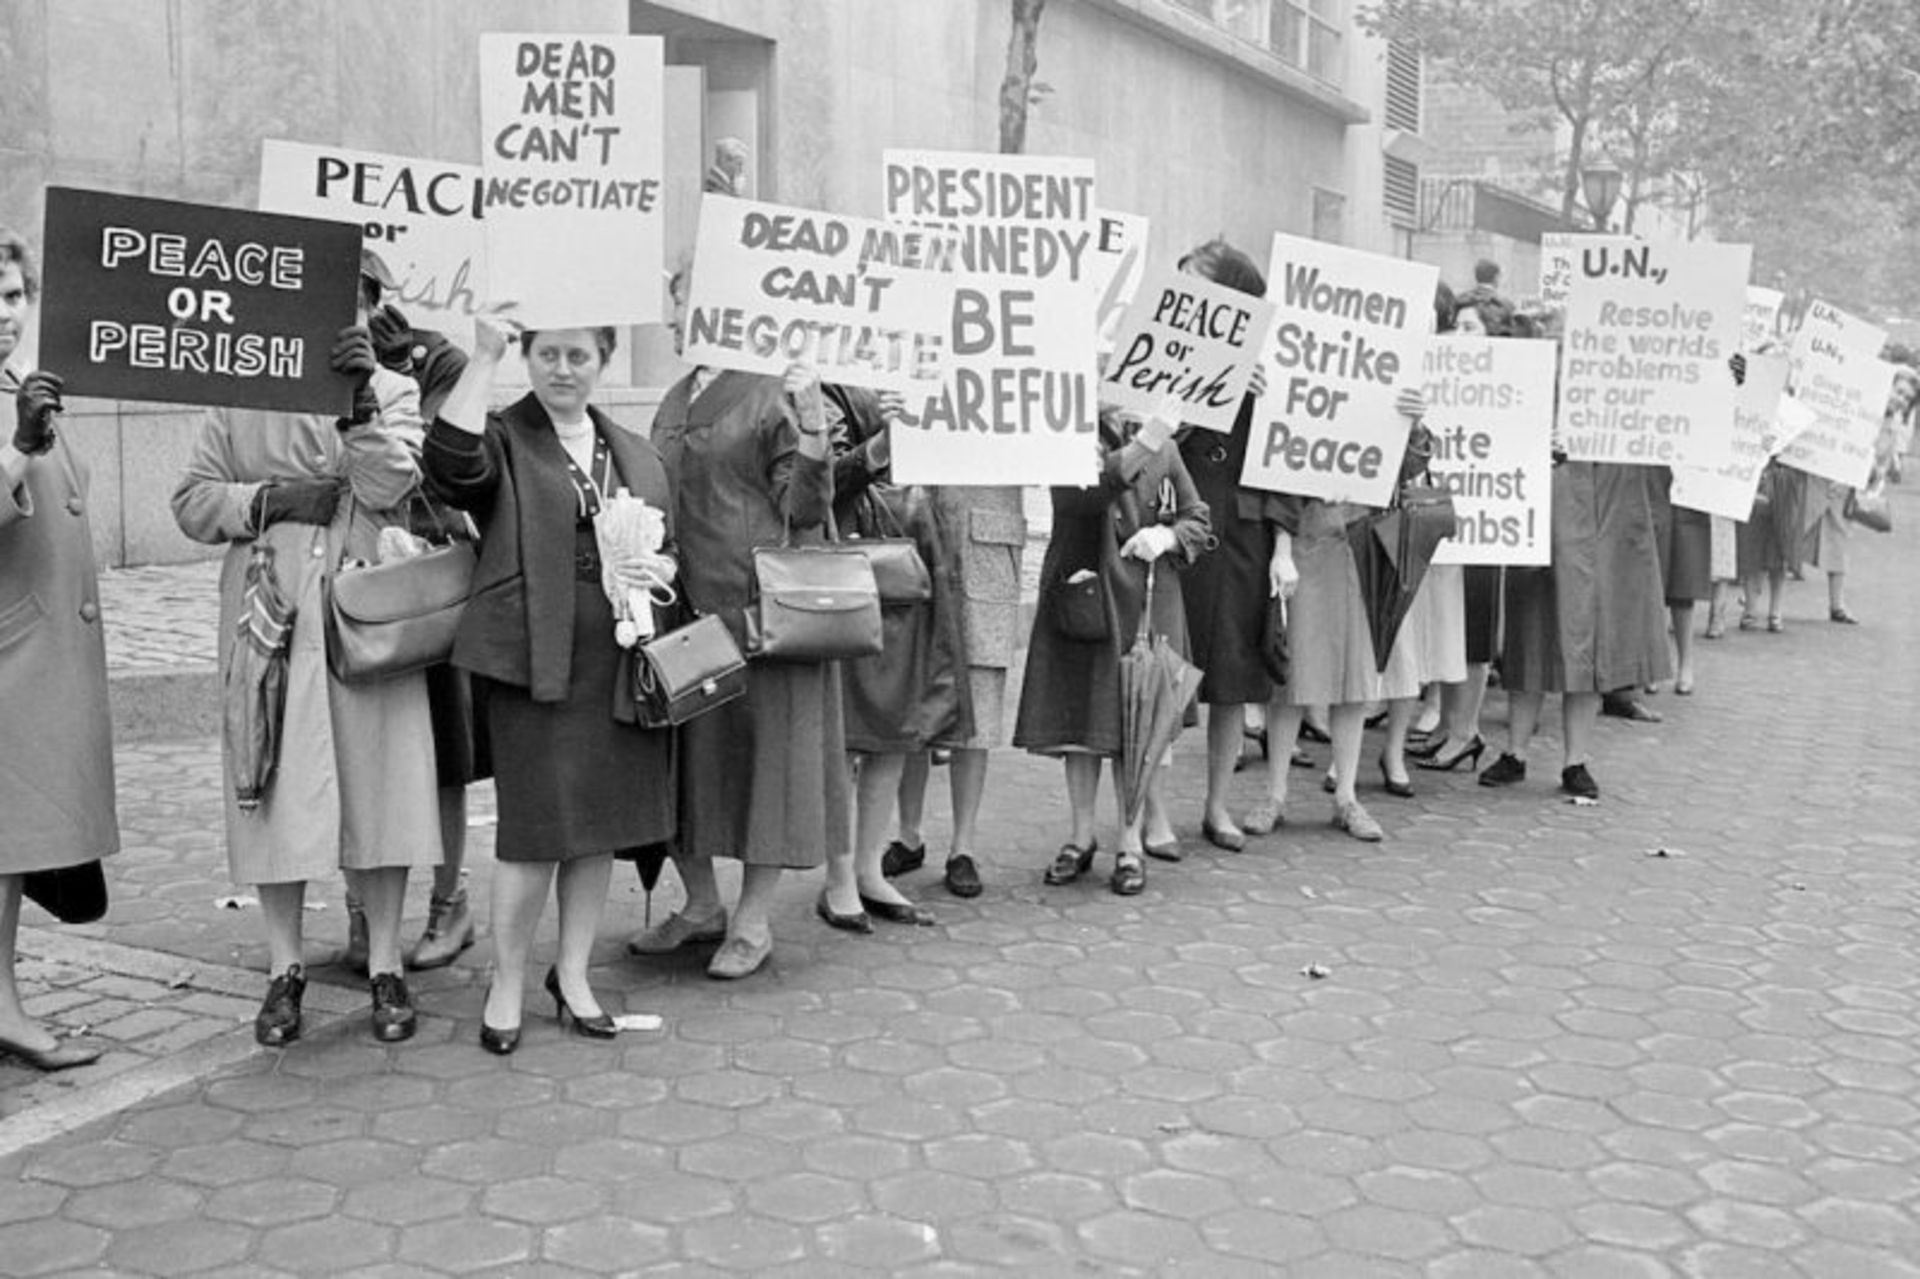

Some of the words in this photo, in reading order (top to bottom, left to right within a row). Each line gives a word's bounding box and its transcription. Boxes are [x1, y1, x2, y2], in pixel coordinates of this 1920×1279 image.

[516, 40, 615, 79] DEAD
[522, 78, 614, 119] MEN
[495, 123, 620, 166] CAN'T
[485, 177, 659, 212] NEGOTIATE
[887, 165, 1094, 221] PRESIDENT
[363, 221, 407, 242] or
[740, 212, 849, 256] DEAD
[857, 228, 957, 273] MEN
[893, 220, 1091, 281] NNEDY
[102, 227, 304, 289] PEACE
[1583, 247, 1667, 284] U.N.,
[167, 286, 235, 324] OR
[392, 258, 482, 315] ish
[761, 264, 894, 313] CAN'T
[1285, 262, 1406, 328] Women
[952, 288, 1035, 356] BE
[1153, 288, 1251, 347] PEACE
[1600, 300, 1713, 331] Resolve
[90, 320, 304, 378] PERISH
[688, 306, 943, 380] NEGOTIATE
[1165, 340, 1194, 362] or
[1275, 323, 1399, 385] Strike
[1422, 346, 1493, 375] nited
[1571, 328, 1616, 353] the
[1628, 332, 1719, 359] worlds
[1106, 333, 1236, 407] Perish
[1568, 353, 1700, 384] problems
[1286, 377, 1349, 421] For
[1420, 376, 1523, 408] ations:
[1566, 387, 1597, 404] or
[1604, 387, 1654, 406] our
[1569, 407, 1690, 435] children
[1262, 421, 1383, 479] Peace
[1430, 425, 1491, 461] nite
[1566, 431, 1616, 456] will
[1627, 434, 1684, 460] die.
[1431, 465, 1526, 501] ainst
[1447, 507, 1535, 548] mbs!
